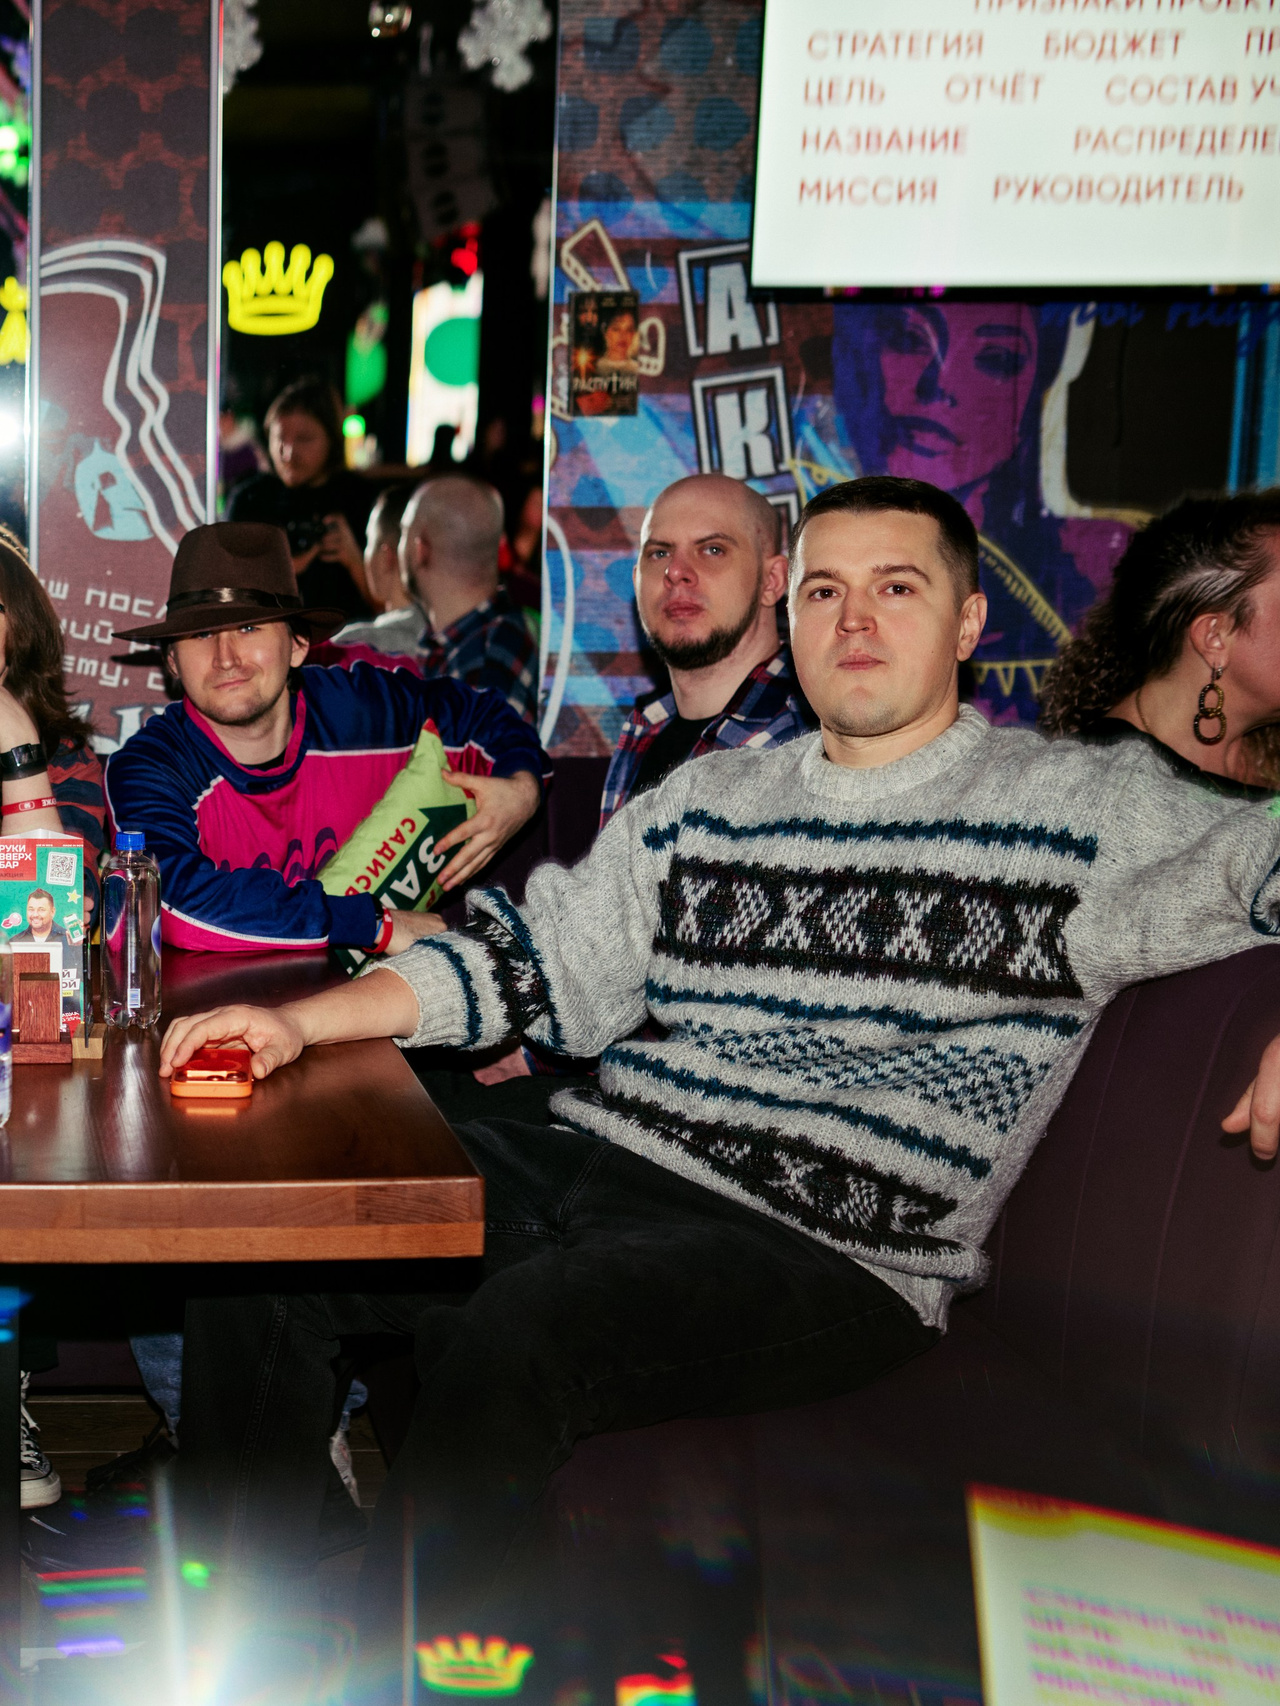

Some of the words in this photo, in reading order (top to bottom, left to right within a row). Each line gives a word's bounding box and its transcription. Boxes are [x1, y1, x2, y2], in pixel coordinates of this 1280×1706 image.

[807, 29, 985, 62] СТРАТЕГИЯ
[1043, 28, 1186, 64] БЮДЖЕТ
[803, 76, 887, 108] ЦЕЛЬ
[944, 70, 1045, 104] ОТЧЁТ
[1104, 75, 1238, 106] СОСТАВ
[801, 126, 967, 157] НАЗВАНИЕ
[799, 177, 938, 206] МИССИЯ
[993, 174, 1245, 207] РУКОВОДИТЕЛЬ
[379, 835, 446, 910] ЗА
